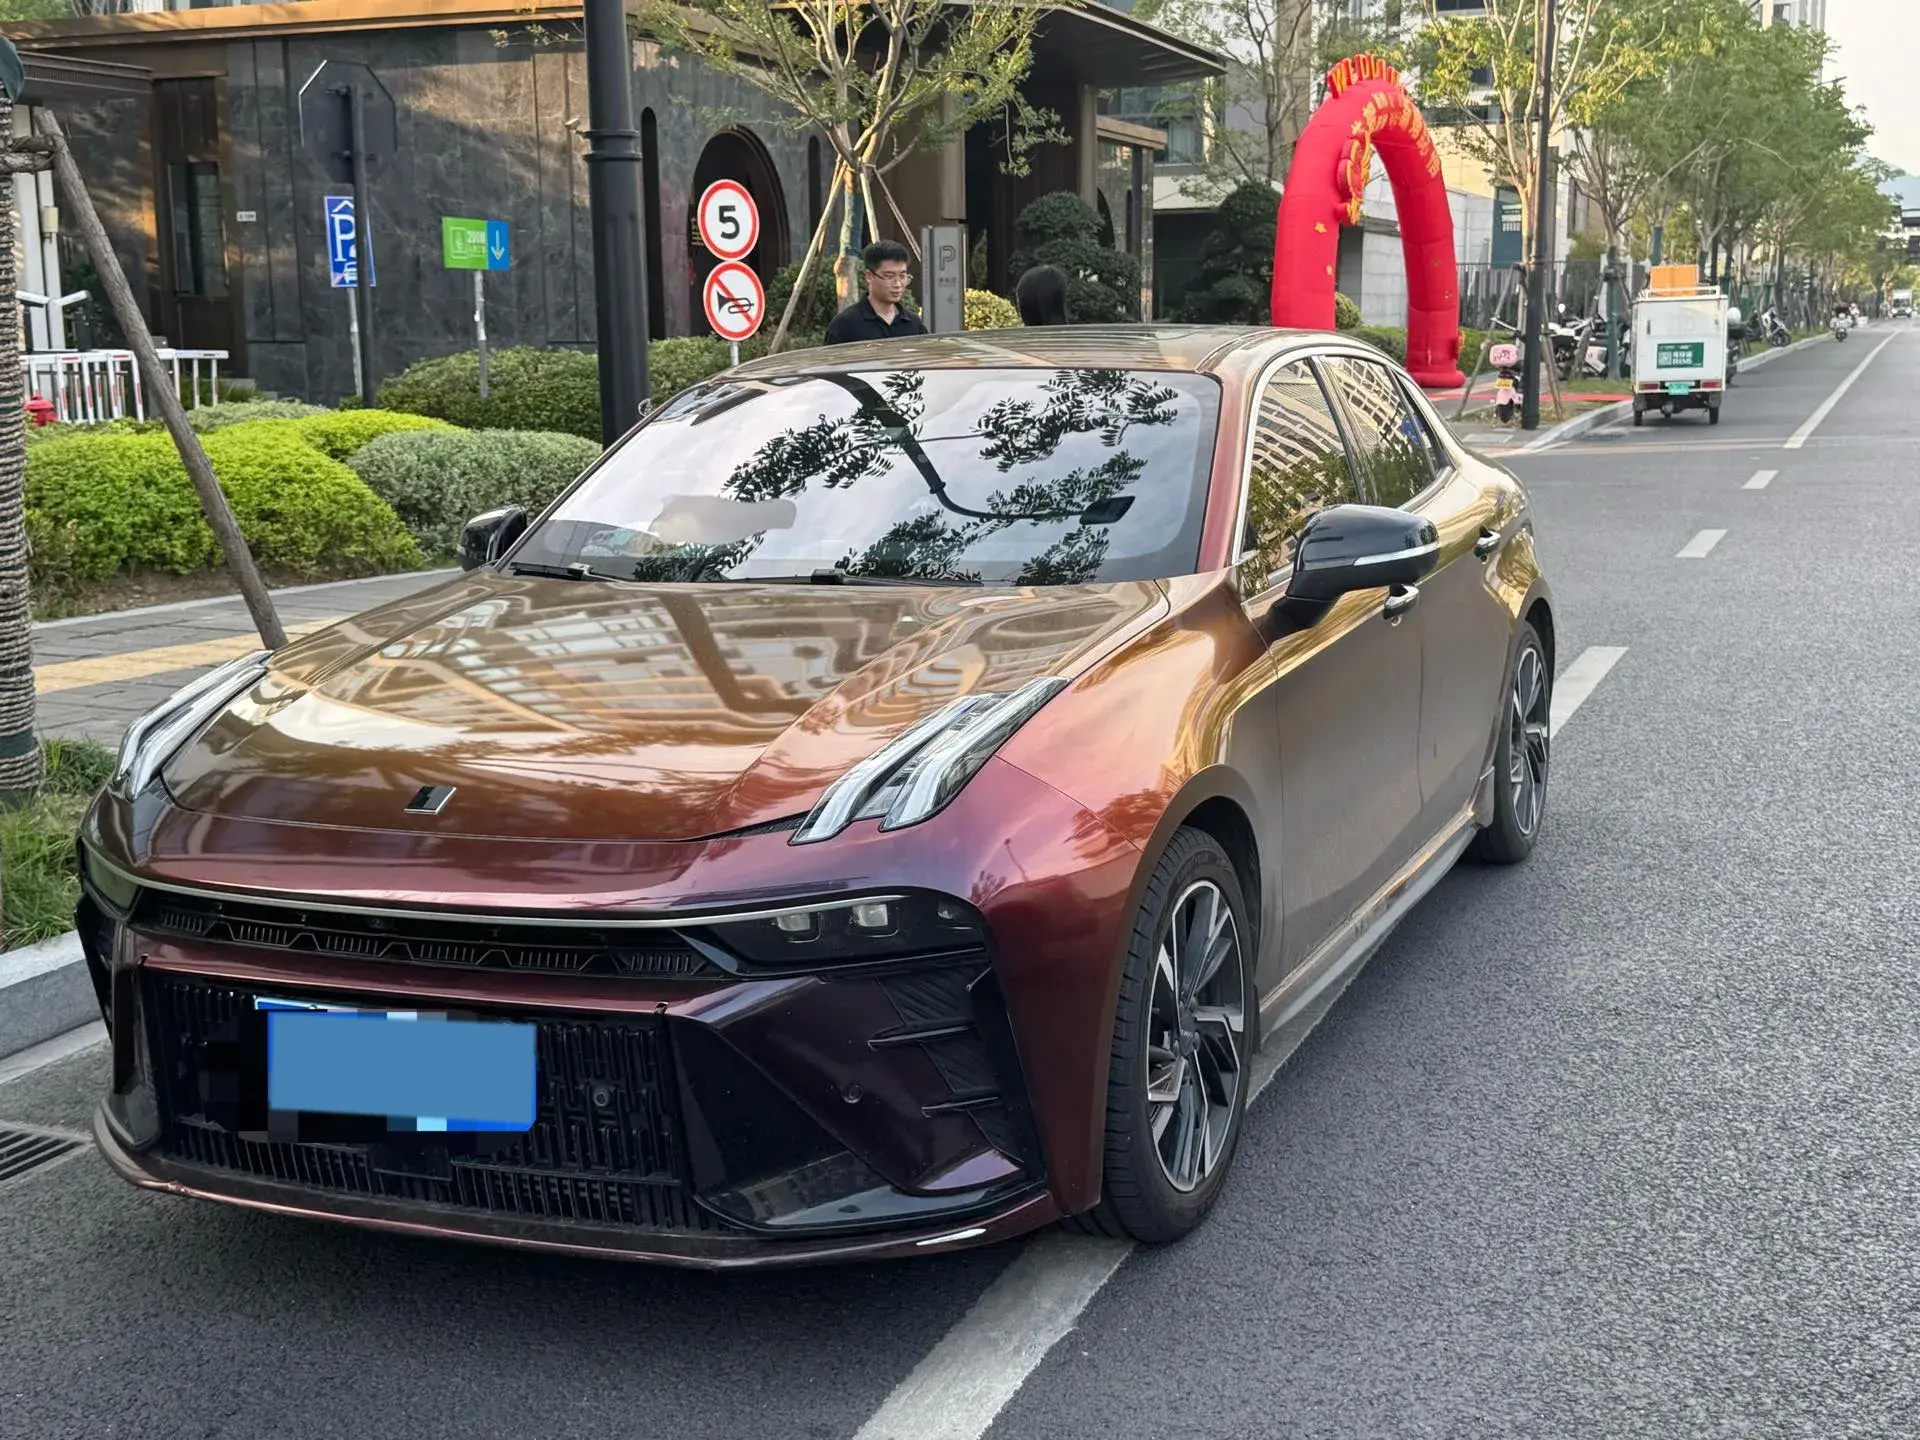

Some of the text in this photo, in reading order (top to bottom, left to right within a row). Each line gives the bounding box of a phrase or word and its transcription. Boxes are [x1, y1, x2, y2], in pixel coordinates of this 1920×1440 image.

[1327, 53, 1409, 100] WEDDIN
[330, 213, 356, 262] P
[719, 205, 740, 240] 5
